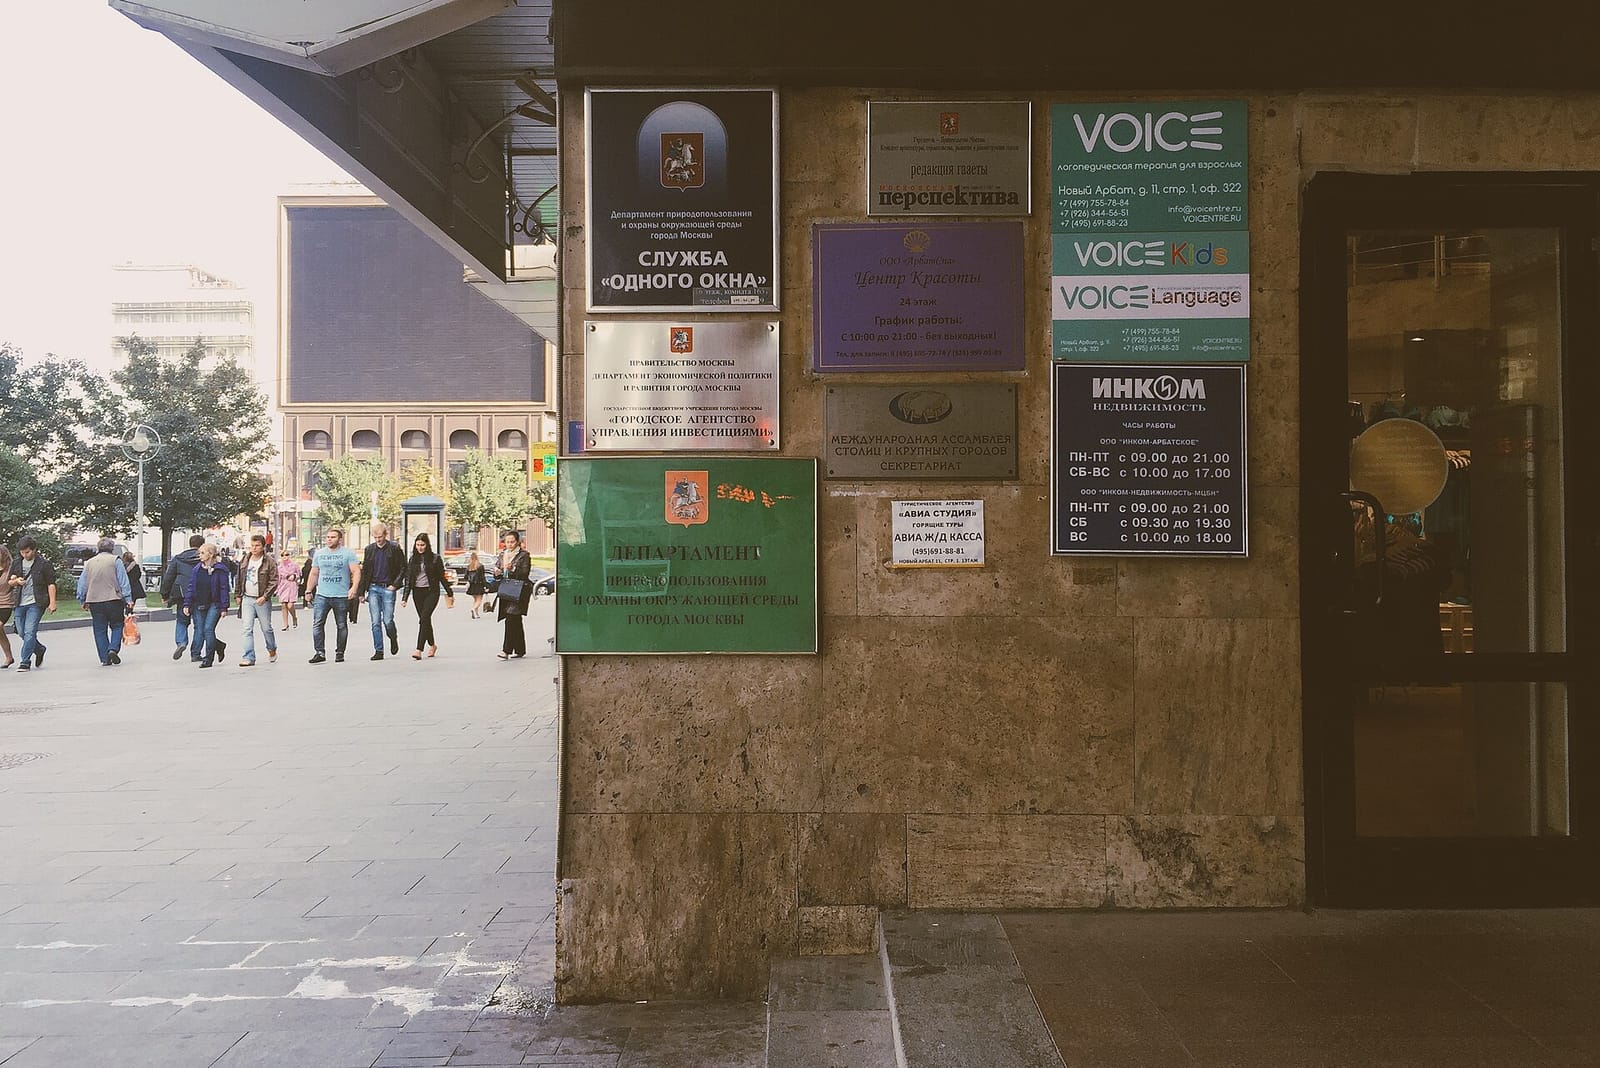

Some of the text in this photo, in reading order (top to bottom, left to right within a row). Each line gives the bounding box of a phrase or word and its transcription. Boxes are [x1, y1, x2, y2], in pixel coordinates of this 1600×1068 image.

[1072, 111, 1223, 153] VOICE
[910, 164, 988, 179] редакция газеты
[1057, 161, 1242, 172] логопедическая терапия для взрослых
[1058, 182, 1242, 198] Новый Арбат, д. 11, стр. 1, оф. 322
[1069, 200, 1089, 208] (499)
[1070, 210, 1090, 218] (926)
[1168, 205, 1242, 214] info@voicentre.ru
[610, 210, 752, 220] Департамент природопользования
[628, 222, 660, 230] охраны
[661, 220, 715, 230] окружающей
[716, 221, 742, 230] среды
[1071, 220, 1090, 228] (495)
[1092, 220, 1128, 228] 691-88-23
[650, 231, 713, 241] города Москвы
[638, 250, 729, 266] СЛУЖБА
[1074, 240, 1164, 267] VOICE
[879, 256, 900, 265] ООО
[600, 274, 693, 292] «ОДНОГО
[699, 272, 767, 288] ОКНА»
[854, 270, 981, 289] Центр Красоты
[900, 298, 912, 306] 24
[1060, 286, 1242, 310] VOICE Language
[874, 315, 962, 328] График работы:
[850, 333, 875, 342] 10:00
[877, 334, 890, 342] до
[892, 332, 918, 341] 21:00
[926, 332, 941, 340] без
[944, 332, 996, 342] выходных!
[652, 371, 726, 380] ЭКОНОМИЧЕСКОЙ
[728, 372, 772, 380] ПОЛИТИКИ
[672, 385, 704, 393] ГОРОДА
[1092, 374, 1206, 400] ИНКОМ
[1093, 402, 1206, 412] НЕДВИЖИМОСТЬ
[609, 415, 756, 424] «ГОРОДСКОЕ АГЕНТСТВО
[592, 428, 774, 438] УПРАВЛЕНИЯ ИНВЕСТИЦИЯМИ»
[831, 434, 1011, 444] МЕЖДУНАРОДНАЯ АССАМБЛЕЯ
[1119, 438, 1200, 446] "ИНКОМ-АРБАТСКОЕ"
[835, 446, 1007, 456] СТОЛИЦ И КРУПНЫХ ГОРОДОВ
[1069, 452, 1230, 464] ПН-ПТ с 09.00 до 21.00
[880, 462, 962, 471] СЕКРЕТАРИАТ
[1069, 467, 1231, 480] СБ-ВС с 10.00 до 17.00
[1080, 488, 1096, 496] ООО
[1070, 502, 1230, 515] ПН-ПТ с 09.00 до 21.00
[898, 510, 977, 518] «АВИА СТУДИЯ»
[1070, 516, 1231, 530] СБ с 09.30 до 19.30
[894, 532, 982, 544] АВИА Ж/Д КАССА
[1070, 532, 1232, 544] ВС с 10.00 до 18.00
[609, 546, 762, 562] ДЕПАРТАМЕНТ
[912, 548, 965, 556] (495)691-88-81
[606, 575, 767, 588] ПРИРОДОПОЛЬЗОВАНИЯ
[573, 593, 799, 606] И ОХРАНЫ ОКРУЖАЮЩЕЙ СРЕДЫ
[628, 614, 744, 626] ГОРОДА МОСКВЫ
